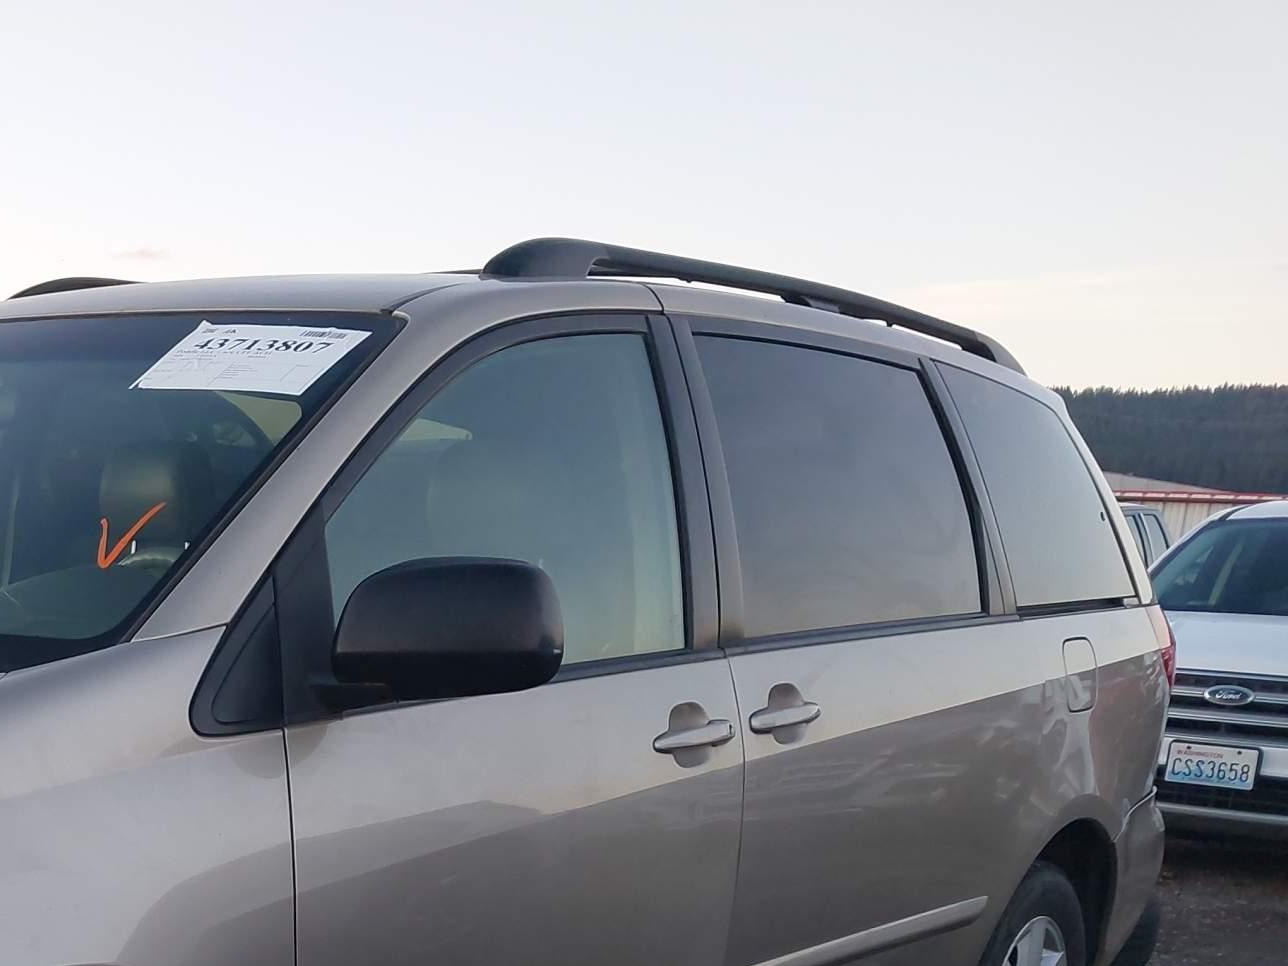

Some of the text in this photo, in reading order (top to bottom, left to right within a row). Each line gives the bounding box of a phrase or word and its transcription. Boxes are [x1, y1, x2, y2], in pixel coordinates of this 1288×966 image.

[194, 338, 333, 354] 43713807
[1215, 690, 1241, 700] Ford
[1172, 758, 1249, 783] CSS3658
